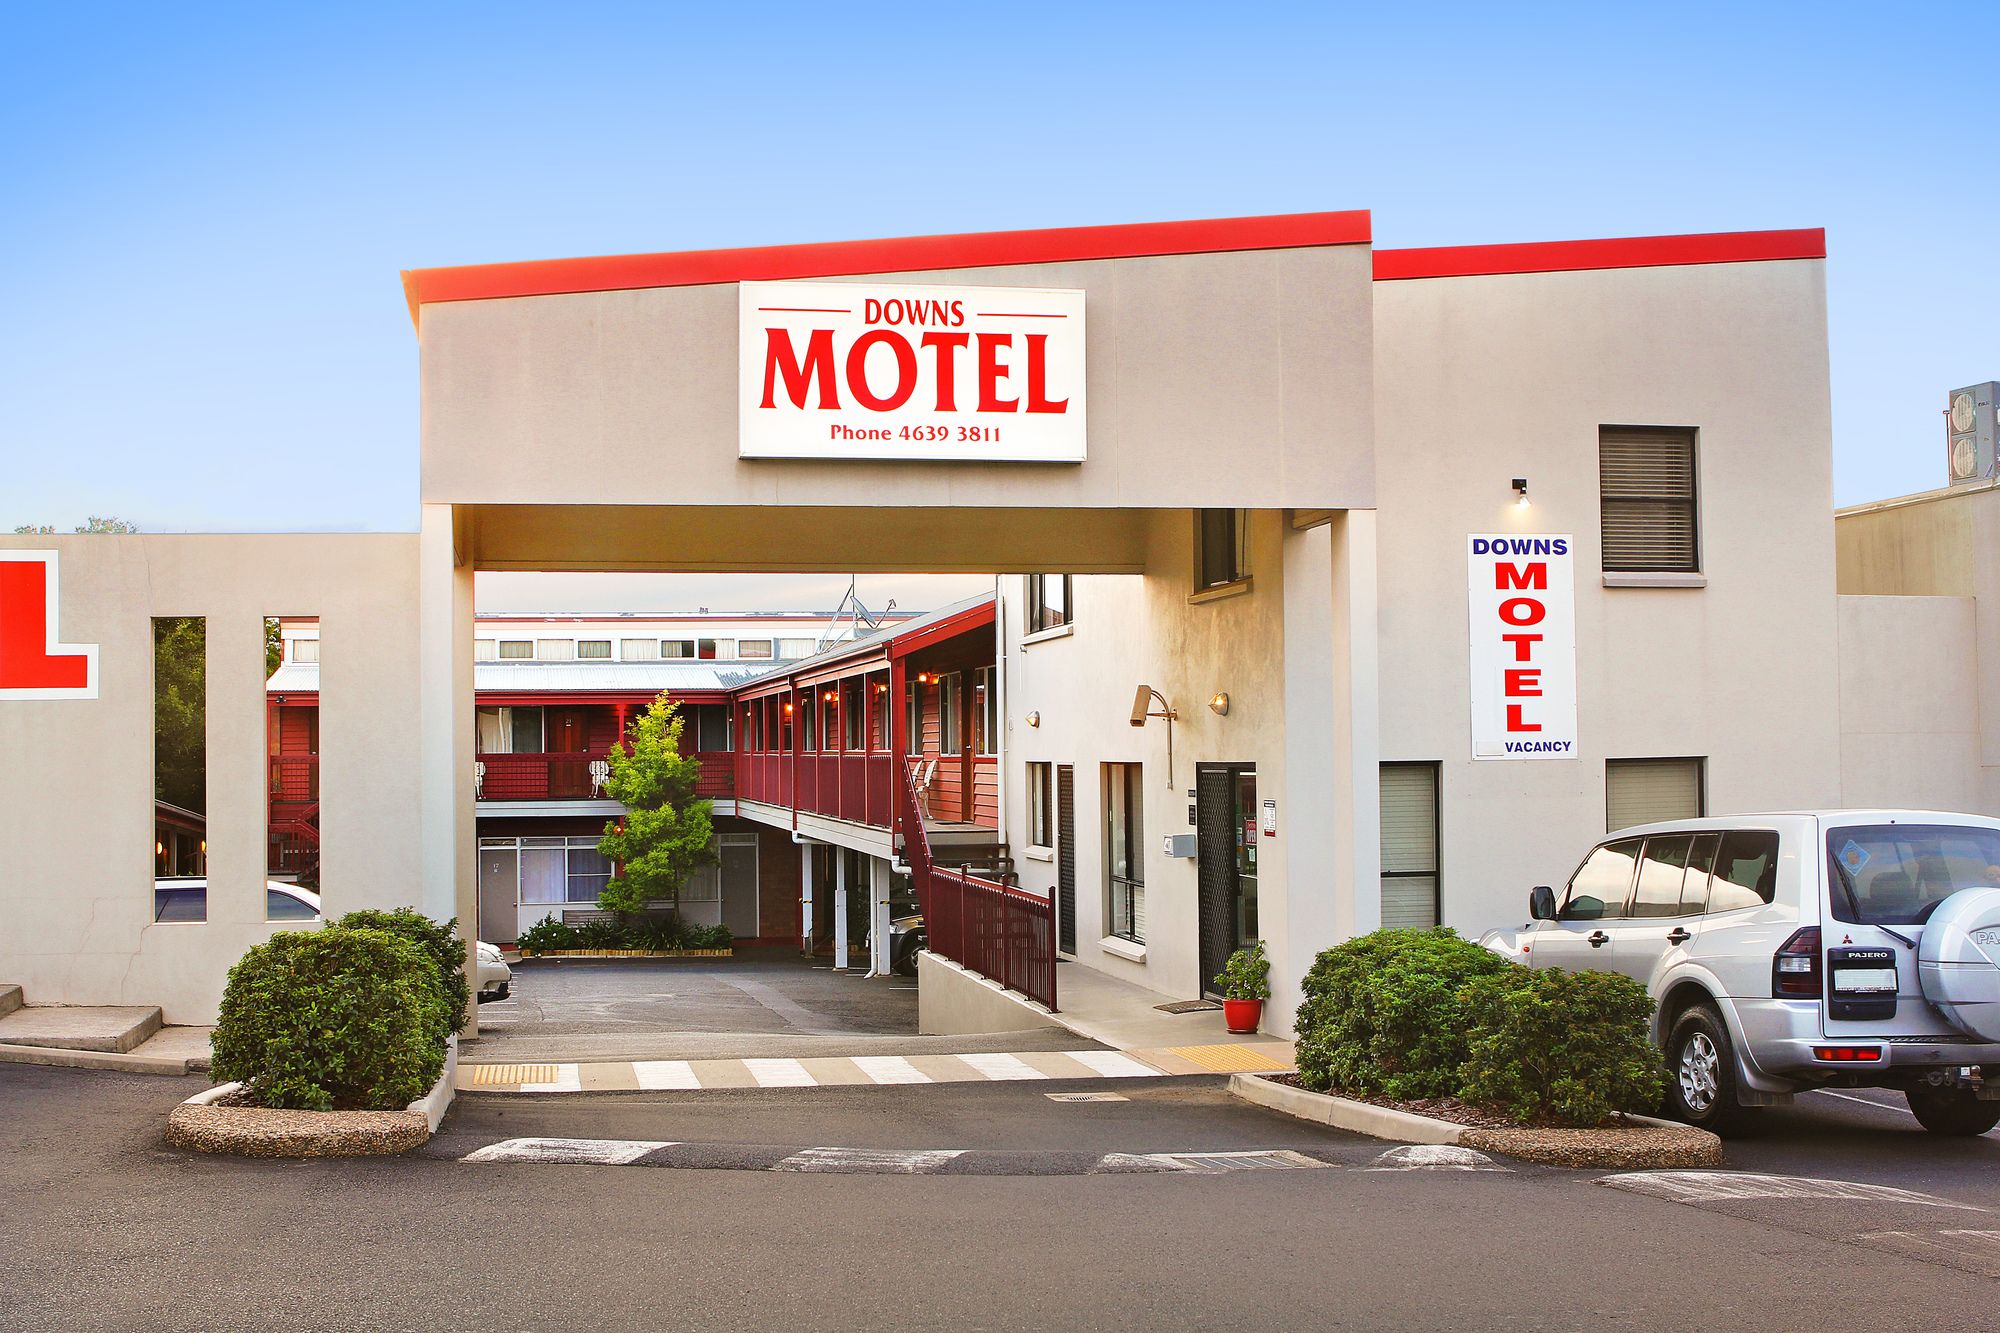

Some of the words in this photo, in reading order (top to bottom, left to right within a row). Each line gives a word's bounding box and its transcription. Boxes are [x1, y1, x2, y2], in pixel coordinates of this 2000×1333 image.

[864, 298, 965, 327] DOWNS
[759, 327, 1069, 414] MOTEL
[830, 424, 892, 440] Phone
[899, 425, 950, 441] 4639
[957, 426, 1000, 442] 3811
[1473, 538, 1568, 555] DOWNS
[1495, 562, 1547, 732] MOTEL
[1505, 741, 1572, 753] VACANCY
